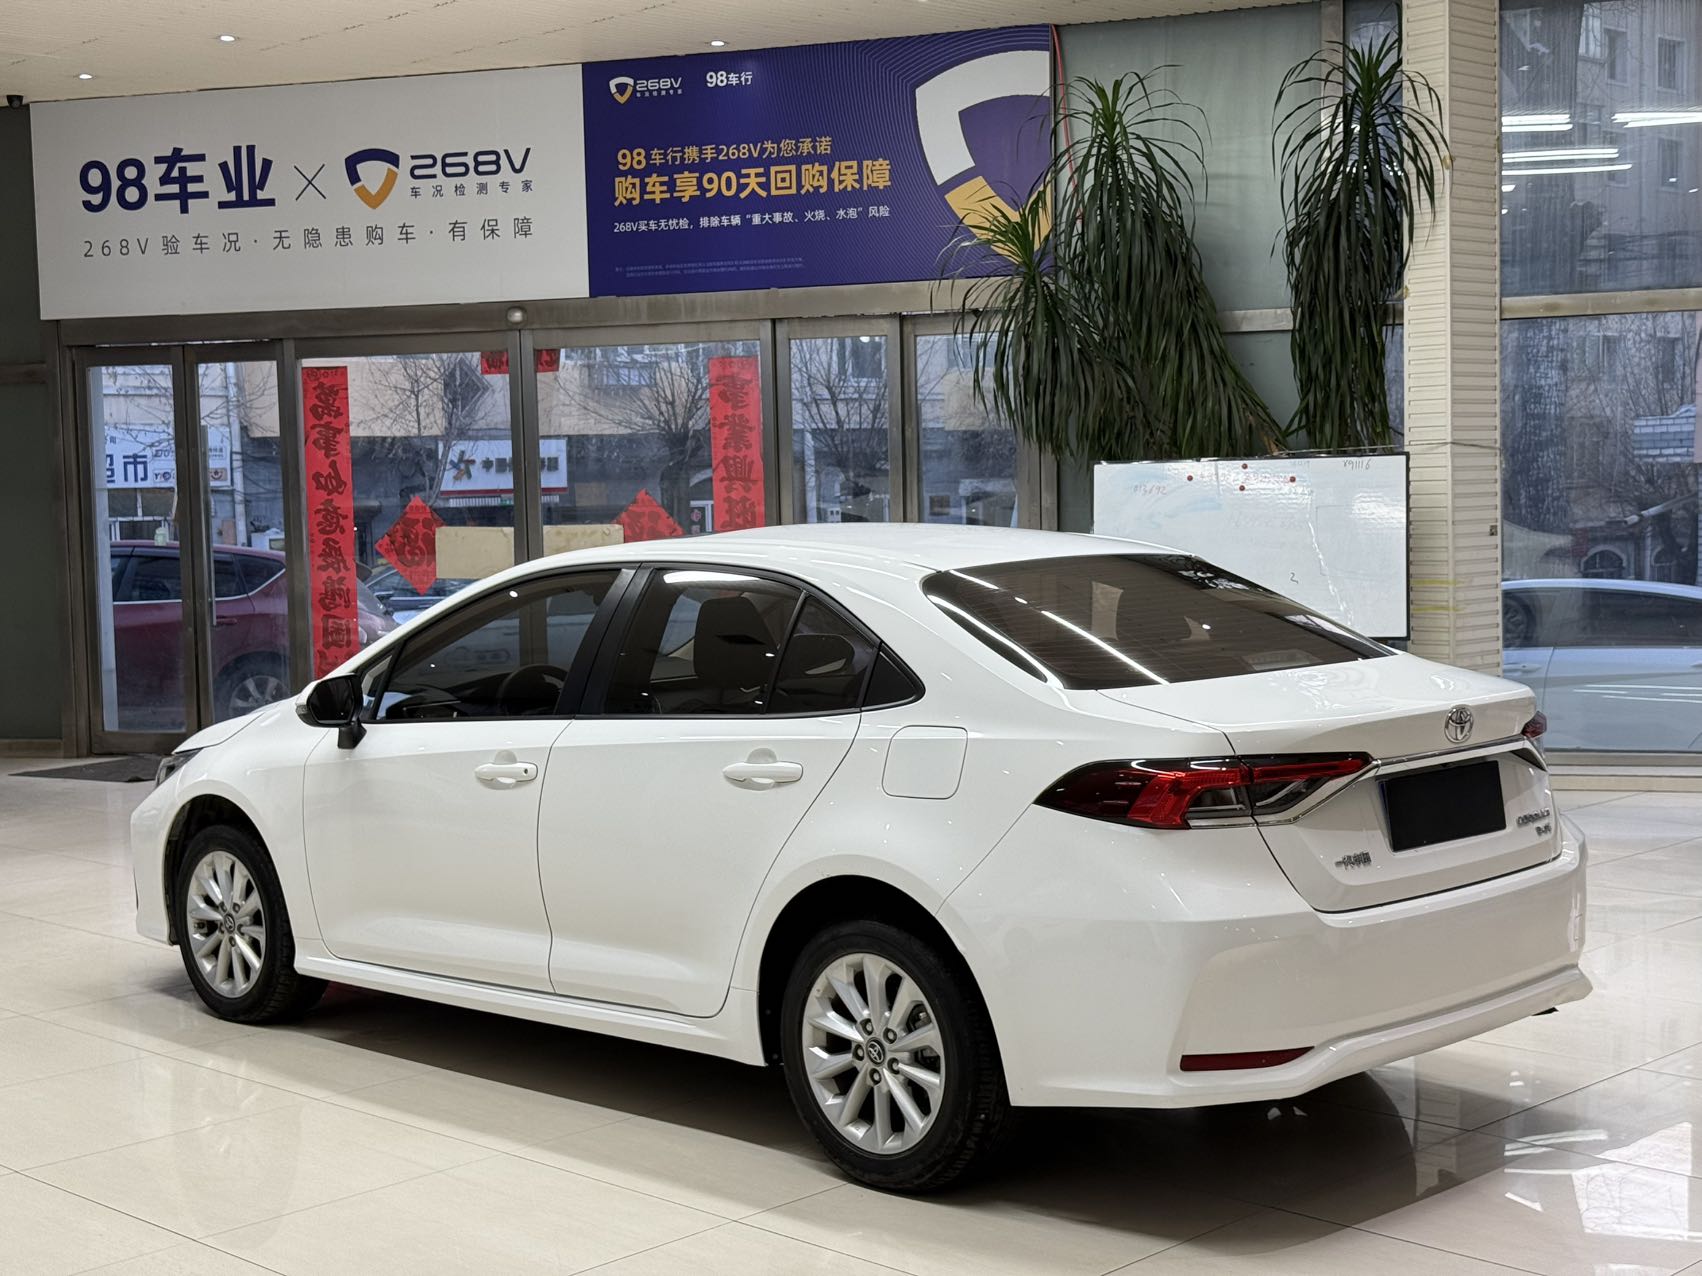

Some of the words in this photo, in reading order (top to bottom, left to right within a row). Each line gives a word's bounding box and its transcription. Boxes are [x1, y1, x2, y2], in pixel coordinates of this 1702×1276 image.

[636, 77, 682, 91] 268V
[706, 71, 753, 88] 98车行
[409, 146, 533, 181] 268V
[79, 144, 276, 214] 98车业
[409, 179, 535, 199] 车况检测专家
[614, 157, 893, 207] 购车享90天回购保障
